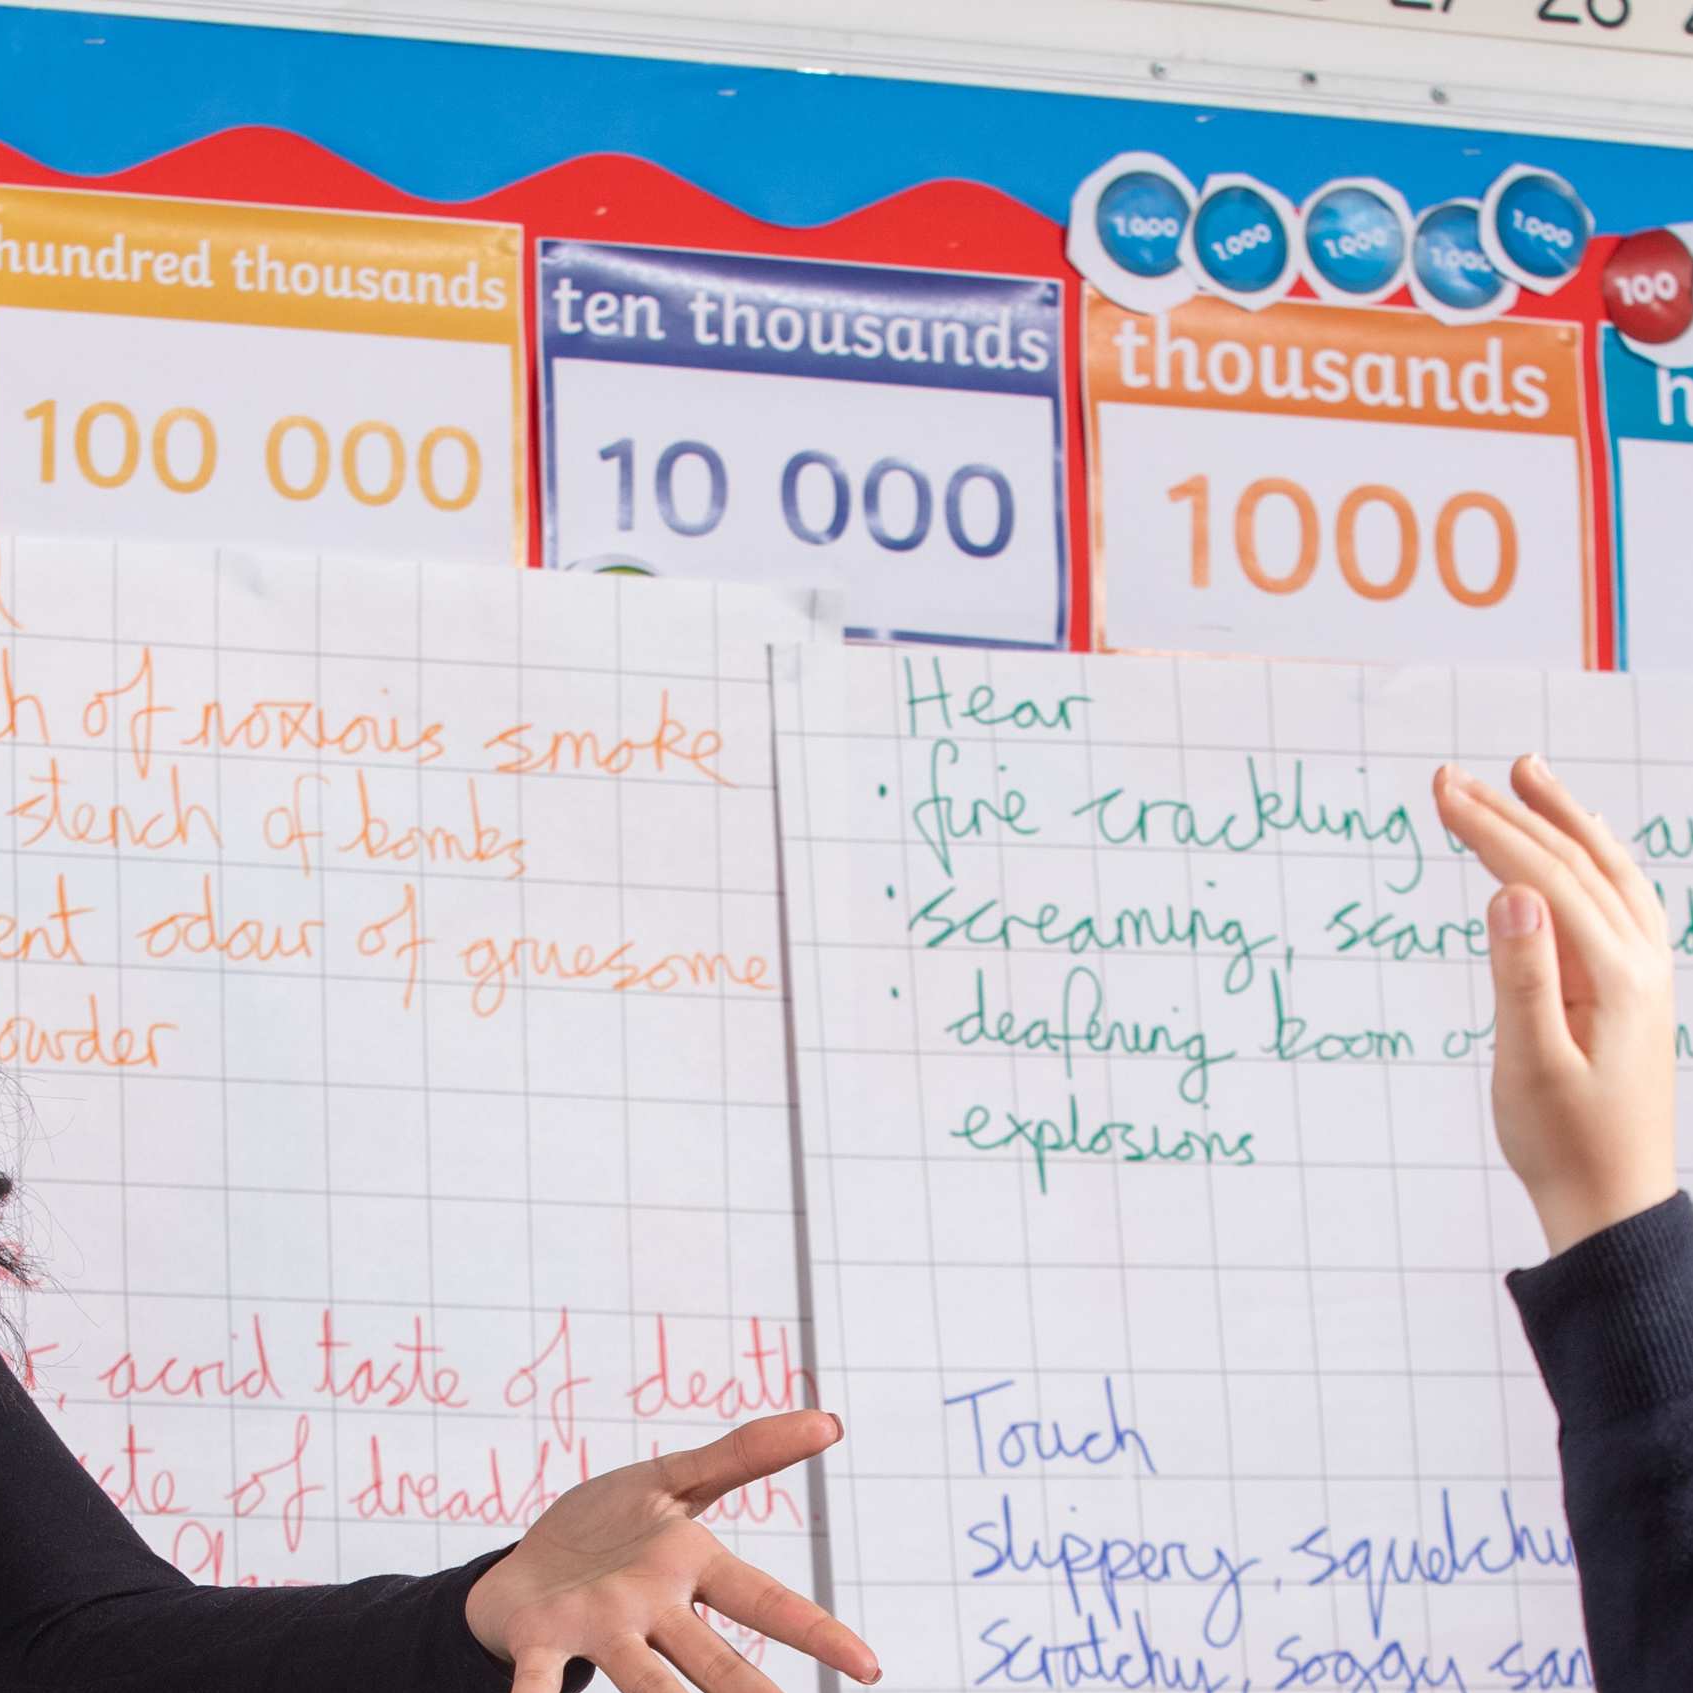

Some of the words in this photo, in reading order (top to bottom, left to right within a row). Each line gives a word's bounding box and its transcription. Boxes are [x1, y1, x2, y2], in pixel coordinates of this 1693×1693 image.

[230, 243, 508, 311] thousands
[552, 277, 667, 341] ten
[689, 284, 1050, 373] thousands
[1615, 270, 1678, 307] 100
[1113, 312, 1551, 420] thousands
[23, 399, 218, 494] 100
[264, 414, 482, 512] 000
[597, 437, 728, 537] 10
[779, 448, 1015, 558] 000
[1167, 473, 1520, 609] 1000
[82, 646, 176, 779] of
[180, 687, 445, 763] noxious
[482, 689, 741, 790] smoke
[903, 655, 1095, 736] Hear
[5, 757, 224, 848] stench
[264, 773, 332, 877] of
[336, 768, 527, 880] bombs
[911, 738, 1040, 879] fire
[1072, 755, 1423, 893] crackling
[135, 873, 326, 961] odour
[356, 883, 438, 1010] of
[456, 936, 780, 1017] gruesome
[944, 966, 1237, 1104] deafening
[1258, 967, 1413, 1061] boom
[949, 1092, 1256, 1196] explosions
[95, 1311, 285, 1401] acrid
[313, 1308, 471, 1408] taste
[504, 1305, 593, 1454] of
[625, 1312, 822, 1420] death
[942, 1375, 1158, 1475] Touch
[223, 1413, 327, 1554] of
